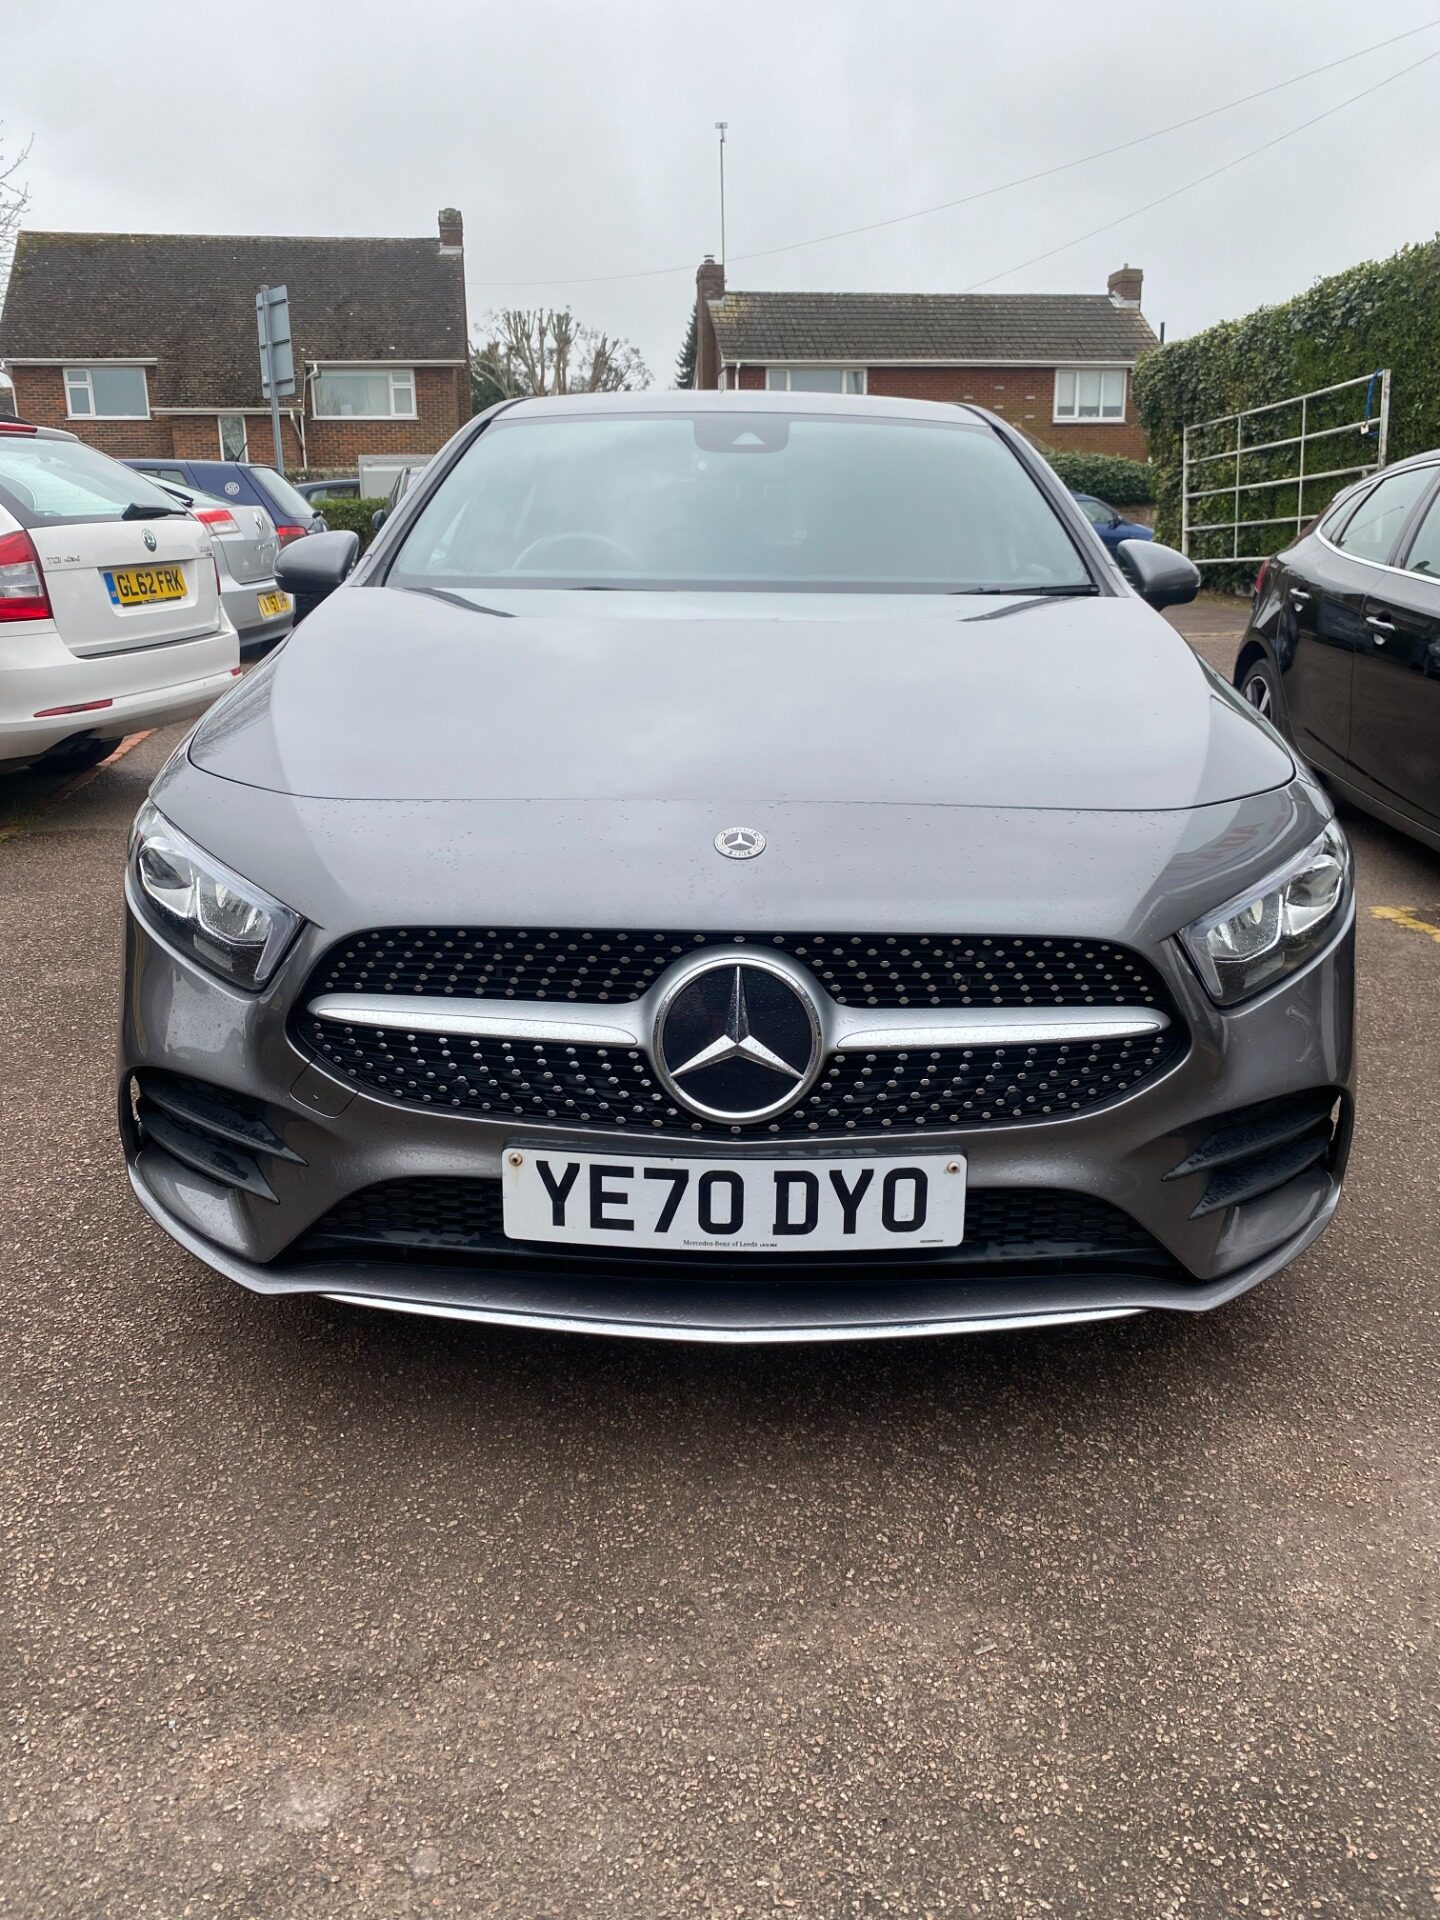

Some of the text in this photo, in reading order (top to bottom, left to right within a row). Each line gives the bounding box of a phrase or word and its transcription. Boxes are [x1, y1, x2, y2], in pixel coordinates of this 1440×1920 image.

[116, 569, 184, 598] GL62 FRK
[535, 1159, 929, 1236] YE70 DYO
[683, 1239, 731, 1248] Mercedes-Benz
